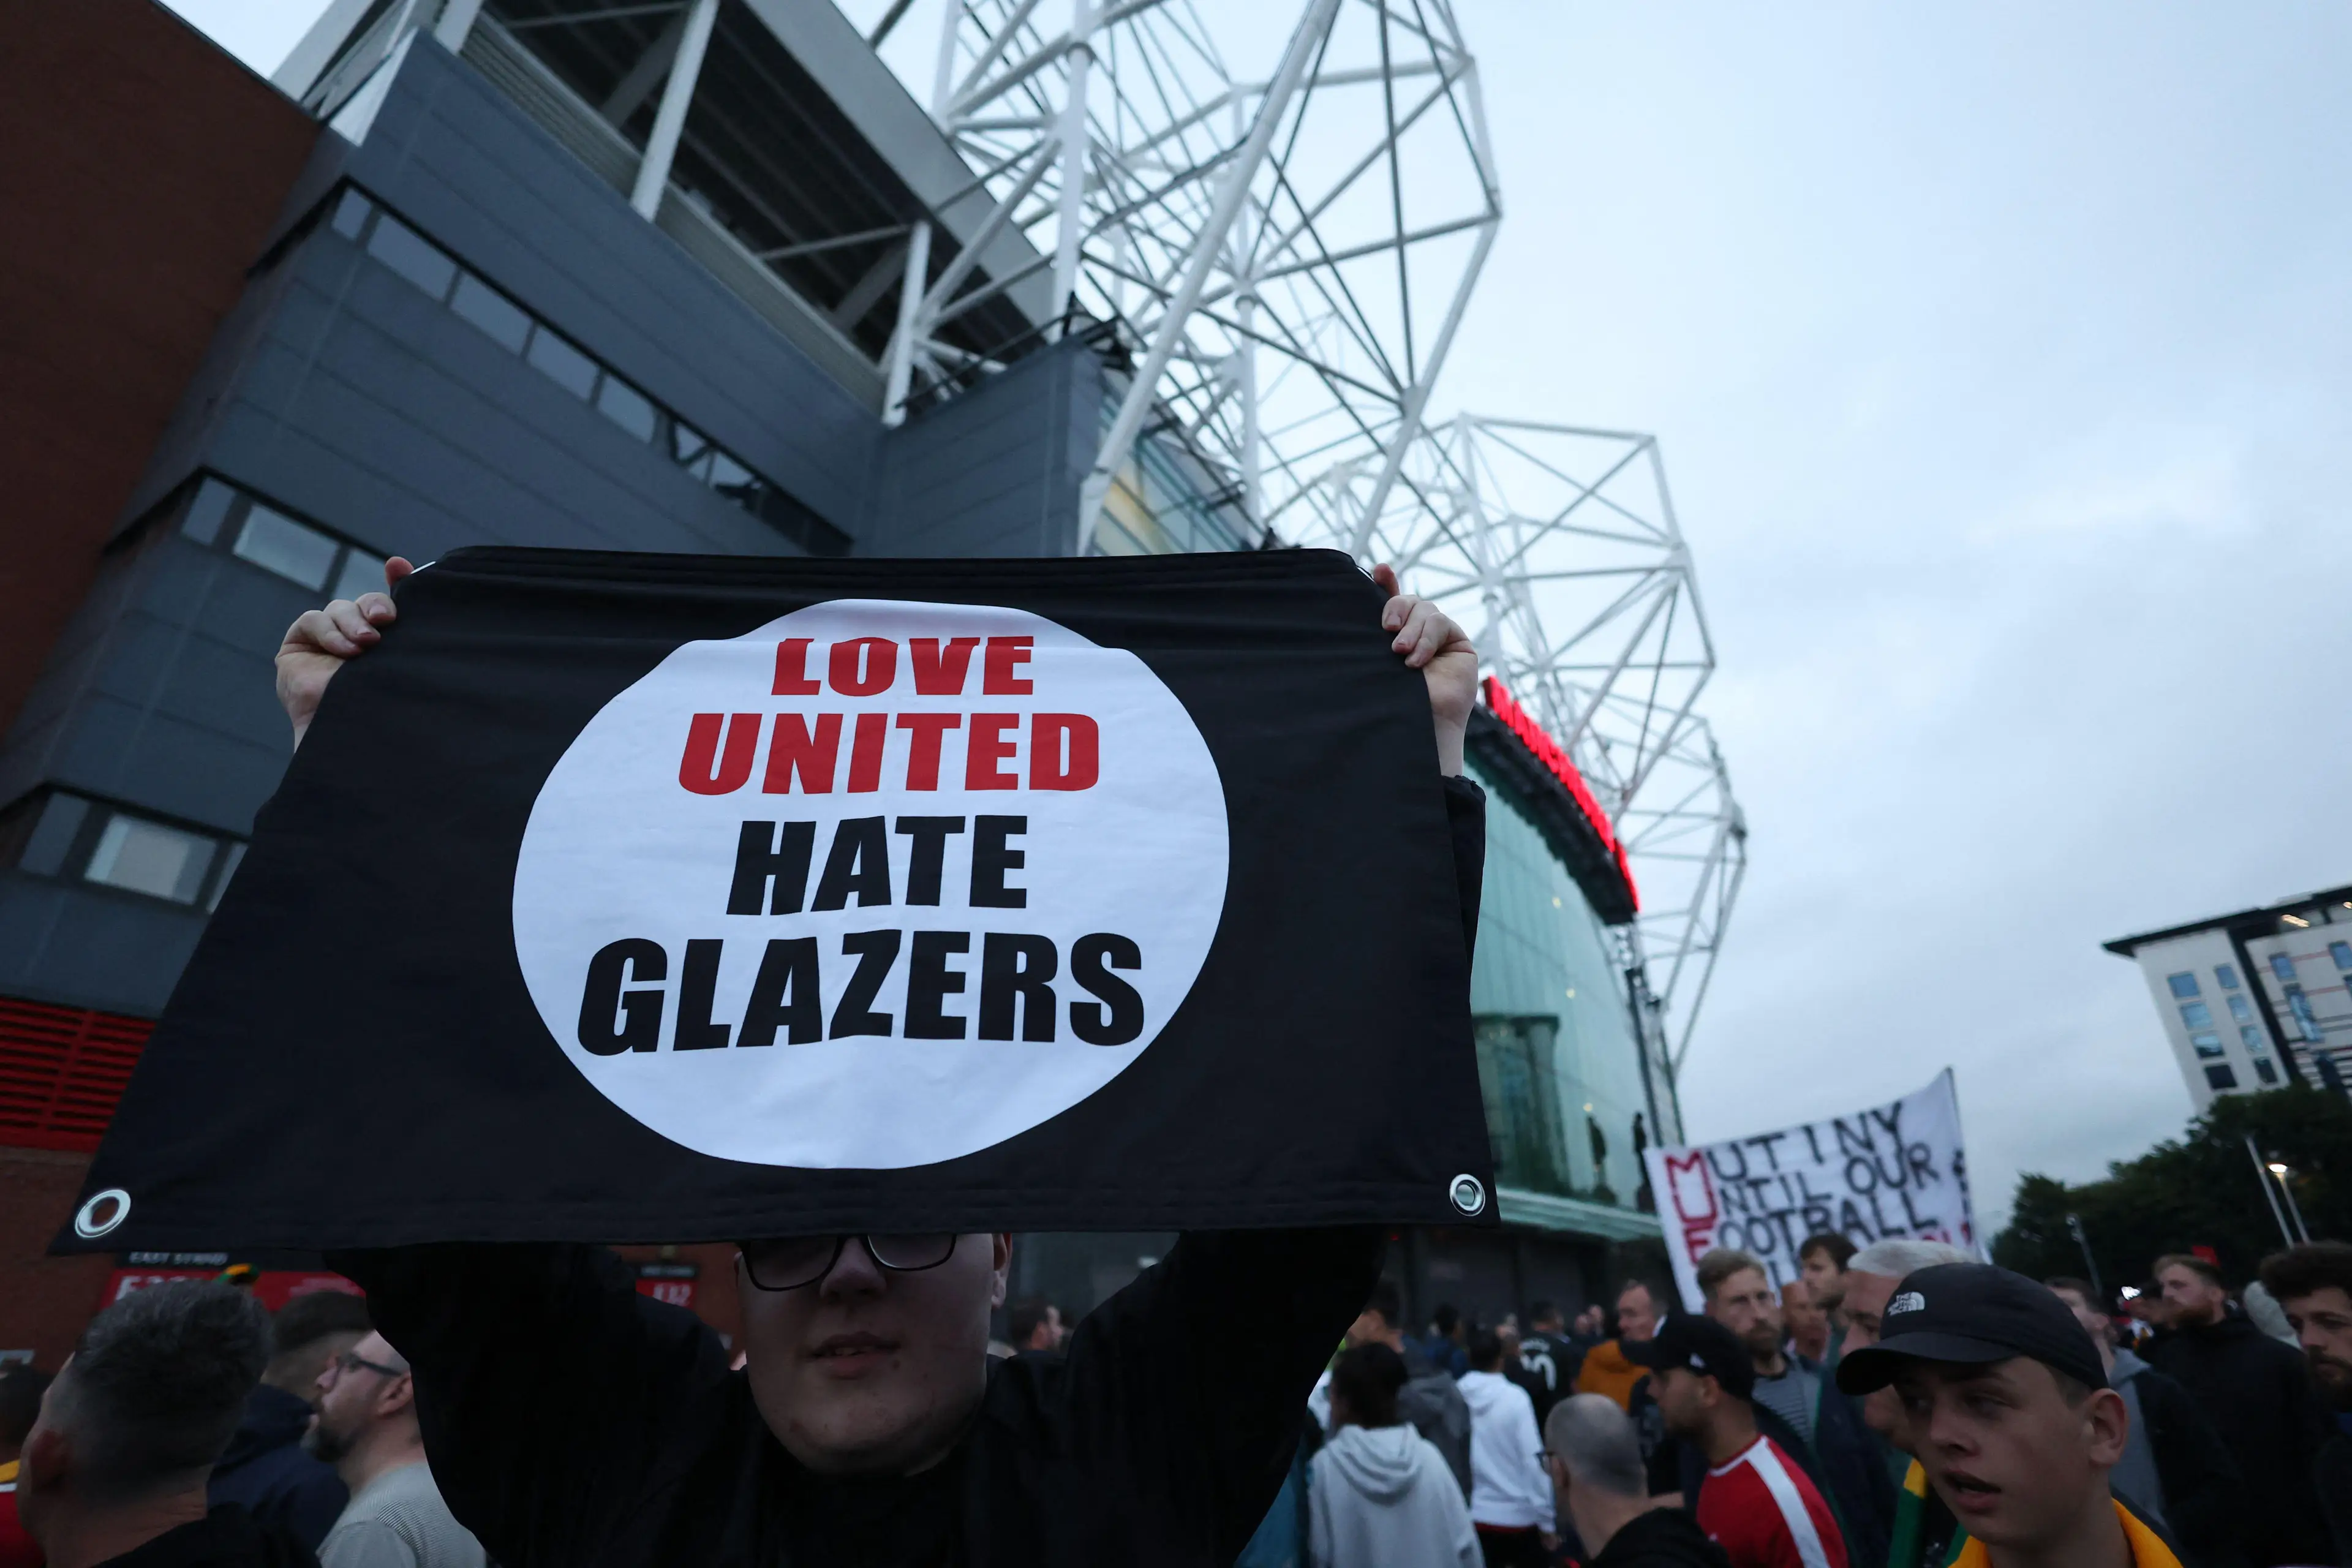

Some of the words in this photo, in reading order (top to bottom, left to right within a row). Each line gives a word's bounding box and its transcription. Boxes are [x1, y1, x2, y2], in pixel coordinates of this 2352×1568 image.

[771, 636, 1033, 696] LOVE
[679, 714, 1098, 795] UNITED
[726, 815, 1027, 915] HATE
[578, 929, 1144, 1056] GLAZERS
[1665, 1101, 1902, 1194] MUTINY
[1845, 1142, 1939, 1195] OUR
[1683, 1190, 1939, 1265] FOOTBALL
